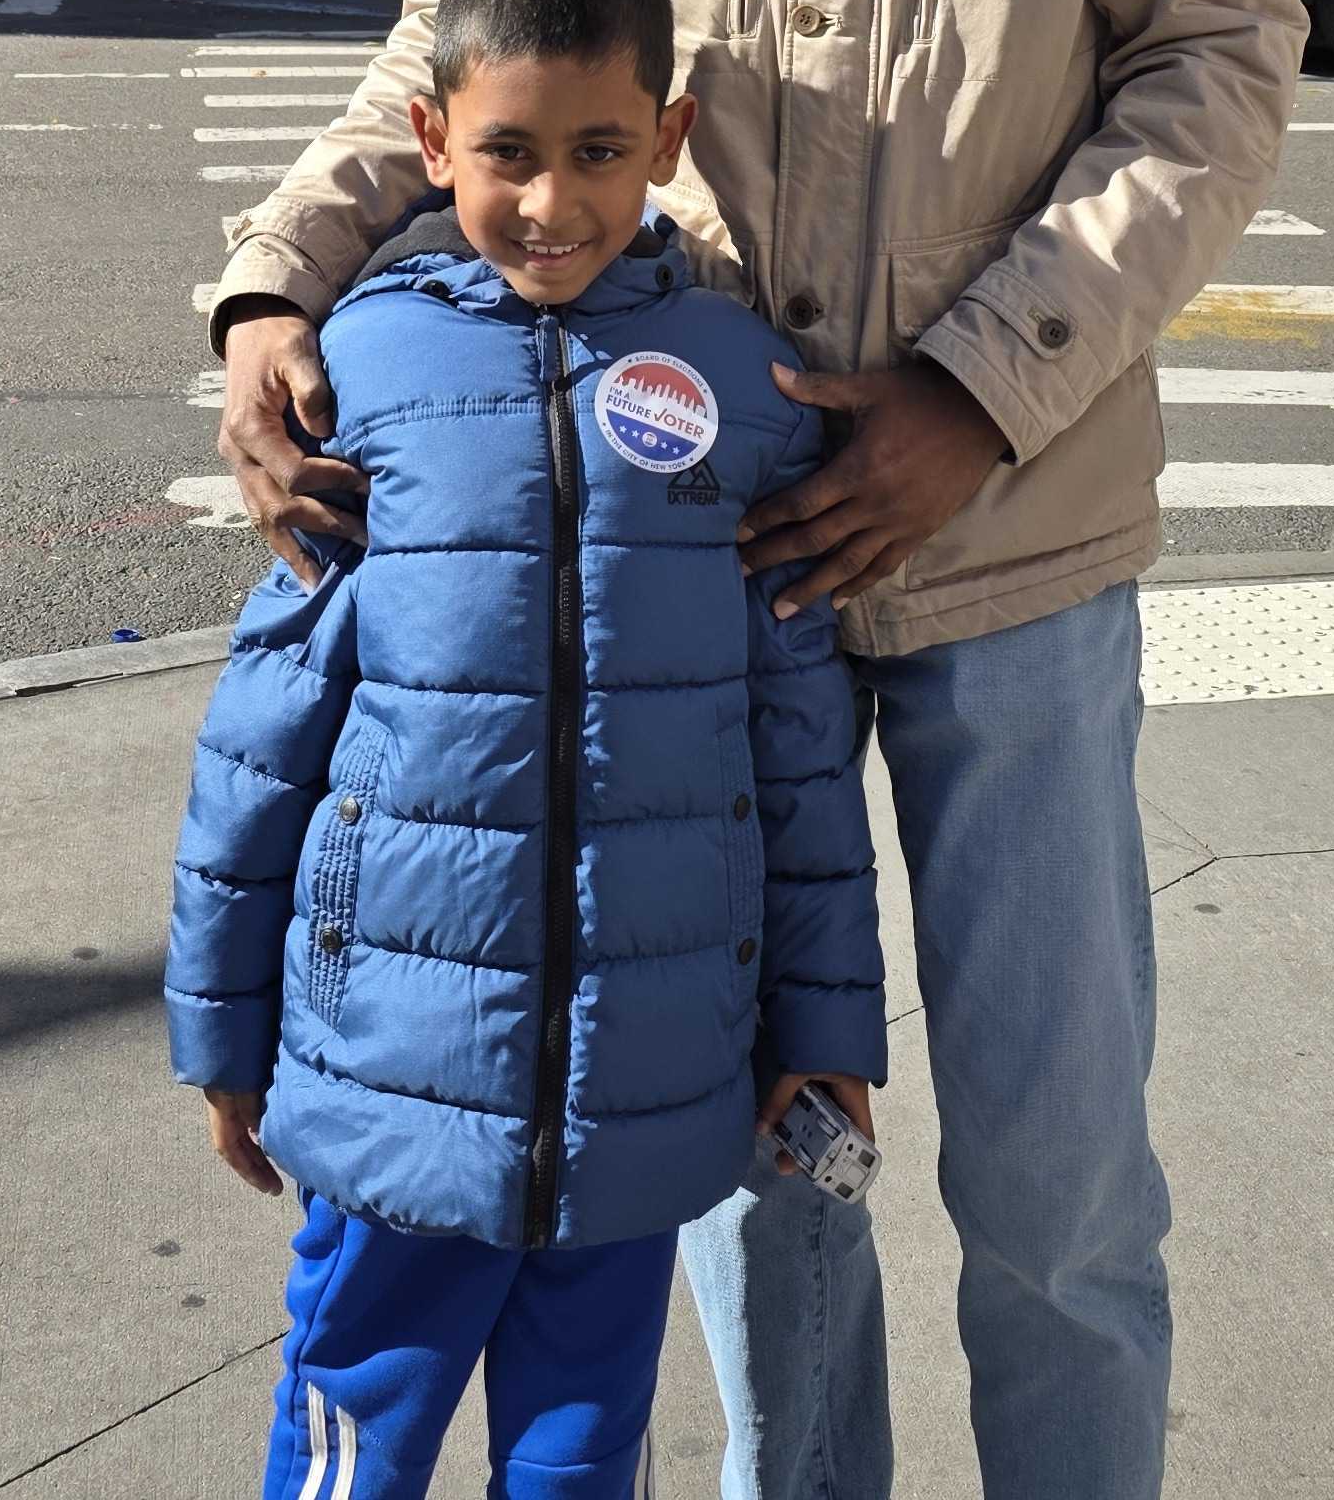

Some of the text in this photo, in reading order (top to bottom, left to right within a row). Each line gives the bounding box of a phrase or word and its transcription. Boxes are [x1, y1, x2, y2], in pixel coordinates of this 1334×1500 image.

[609, 386, 630, 400] I'M A
[606, 395, 652, 418] FUTURE
